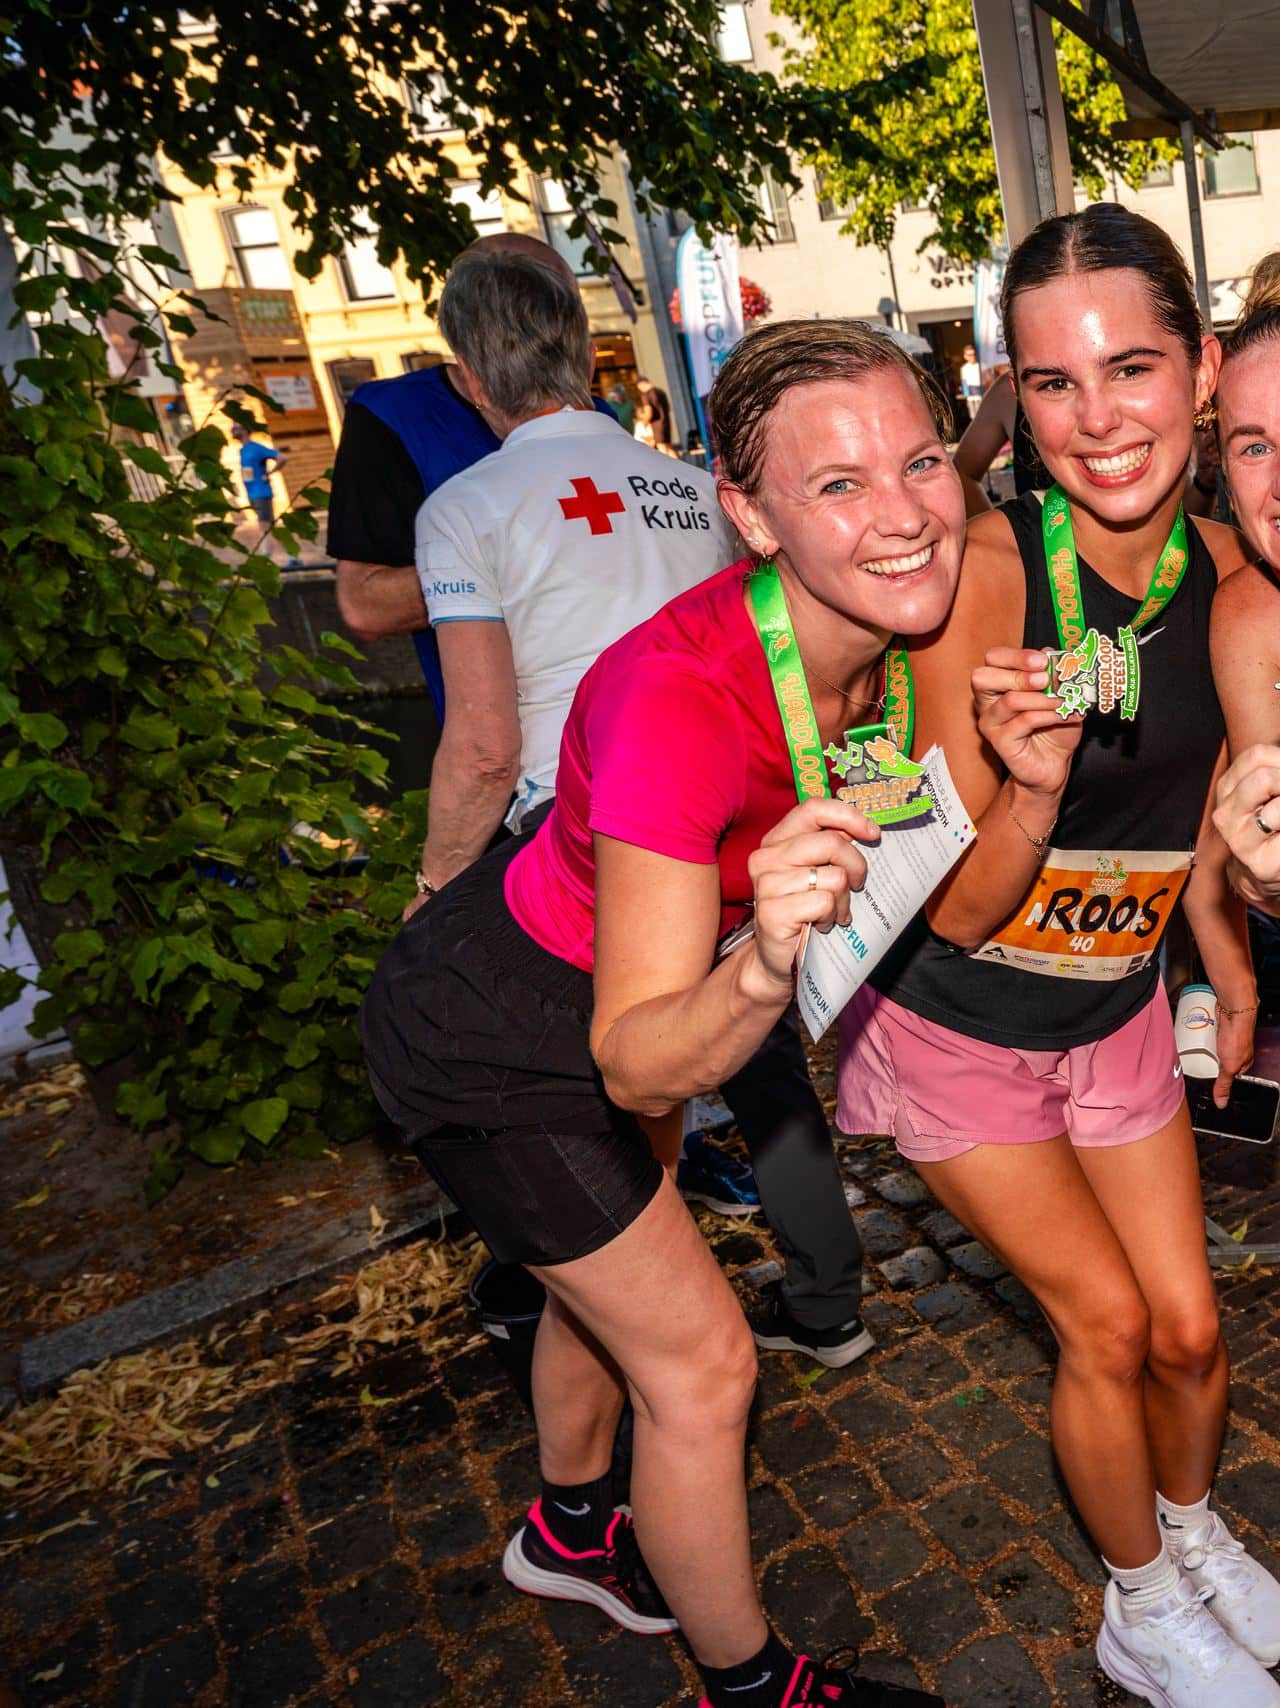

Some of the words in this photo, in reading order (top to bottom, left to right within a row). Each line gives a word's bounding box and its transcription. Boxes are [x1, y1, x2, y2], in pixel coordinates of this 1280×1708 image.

[627, 475, 699, 502] Rode
[641, 504, 711, 531] Kruis
[1154, 547, 1186, 589] 2026
[433, 579, 477, 596] Kruis
[1100, 635, 1114, 712] HARDLOOP
[1113, 651, 1126, 697] FEEST
[1036, 887, 1169, 938] ROOS
[1069, 935, 1096, 953] 40
